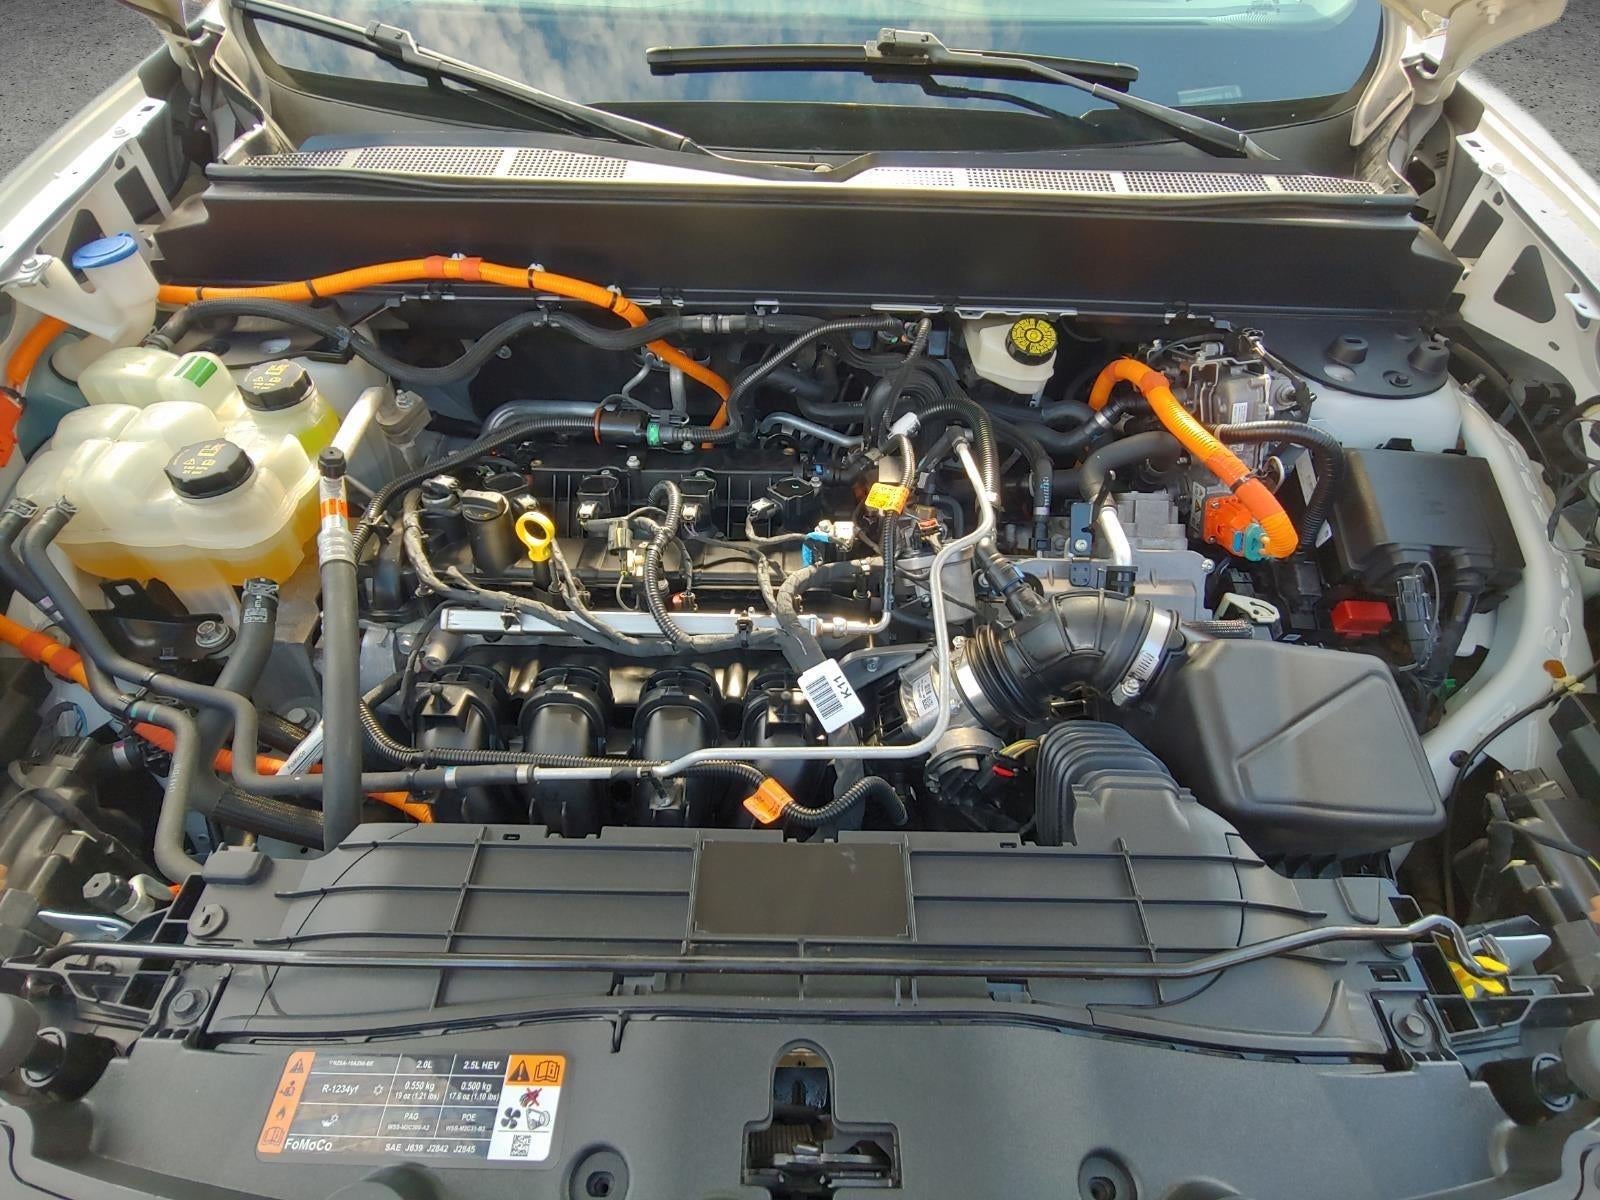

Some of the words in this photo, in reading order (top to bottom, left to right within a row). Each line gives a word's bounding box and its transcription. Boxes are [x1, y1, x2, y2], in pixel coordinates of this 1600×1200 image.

[416, 1060, 433, 1069] 2.0L
[463, 1060, 480, 1070] 2.5L
[481, 1060, 500, 1070] HEV
[404, 1080, 424, 1090] 0.550
[425, 1081, 436, 1092] kg
[460, 1081, 481, 1091] 0.500
[482, 1081, 492, 1093] kg
[461, 1113, 477, 1122] POE
[284, 1138, 333, 1152] FoMoCo
[385, 1143, 402, 1152] SAE
[405, 1144, 424, 1152] J639
[426, 1144, 449, 1153] J2842
